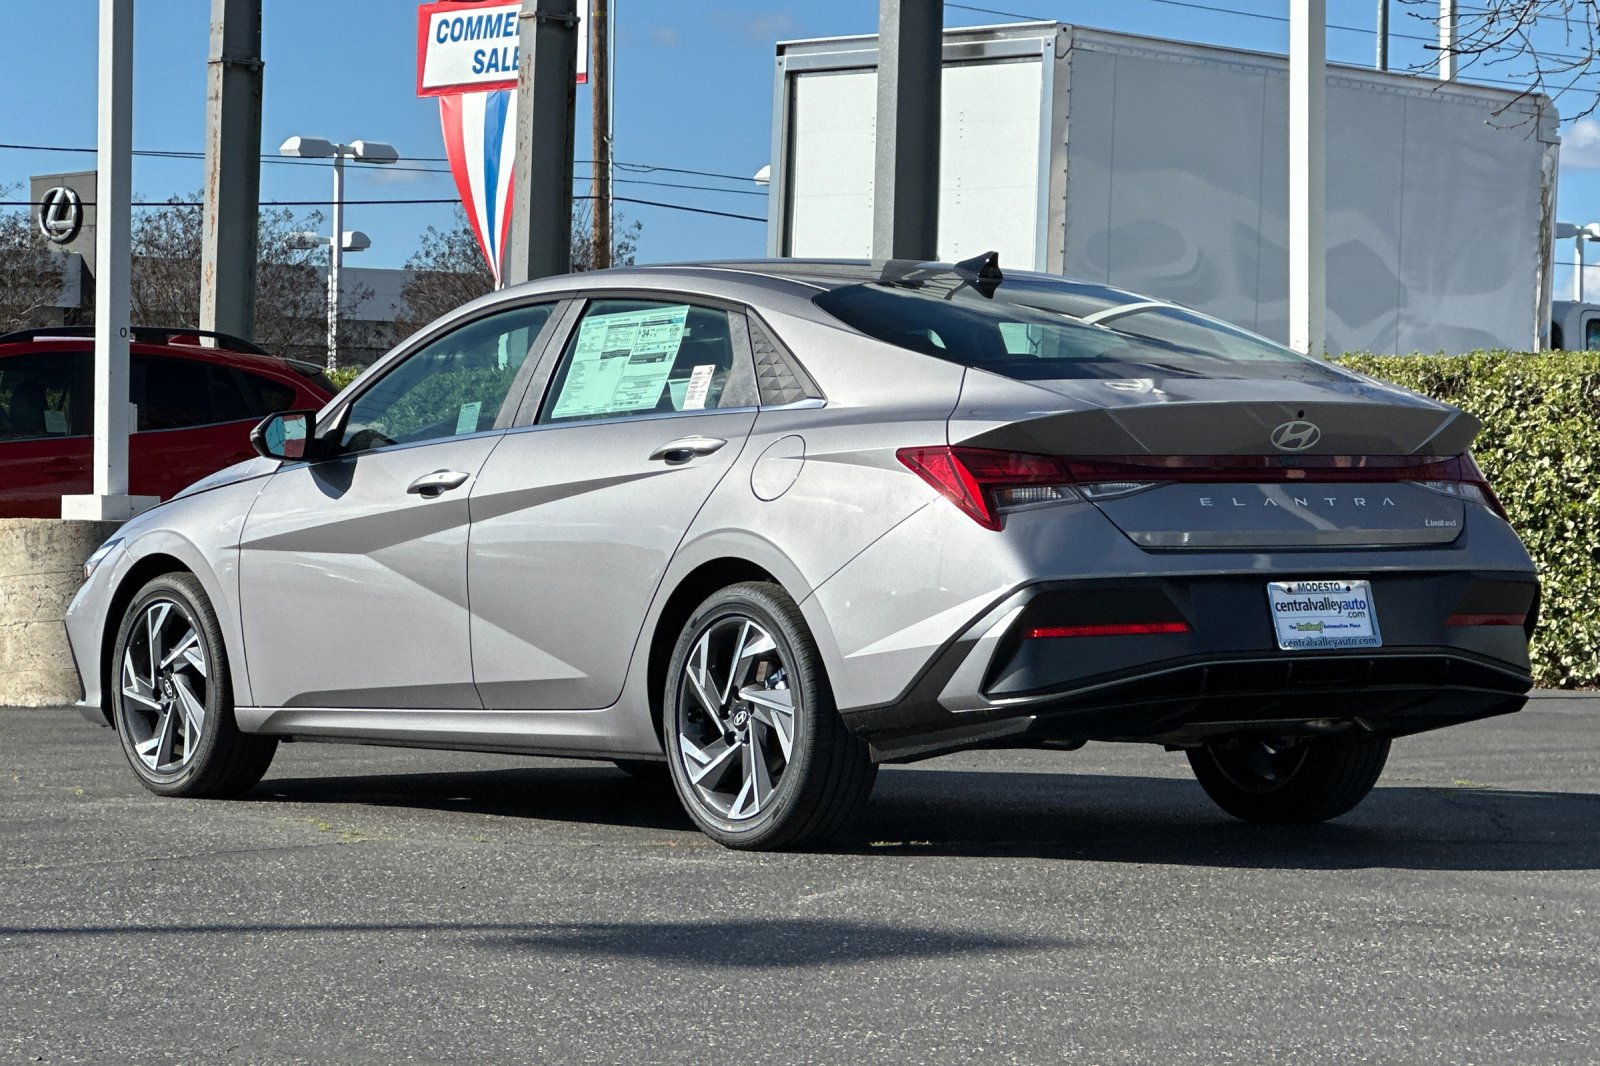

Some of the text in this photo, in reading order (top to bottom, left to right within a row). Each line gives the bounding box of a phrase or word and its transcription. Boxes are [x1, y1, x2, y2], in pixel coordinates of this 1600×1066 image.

[436, 12, 519, 44] COMME
[1199, 497, 1395, 506] ELANTRA
[1425, 518, 1457, 527] Limited
[1297, 582, 1341, 592] MODESTO
[1275, 597, 1366, 614] centralvalleyauto
[1284, 636, 1377, 648] centralvalleyauto.com
